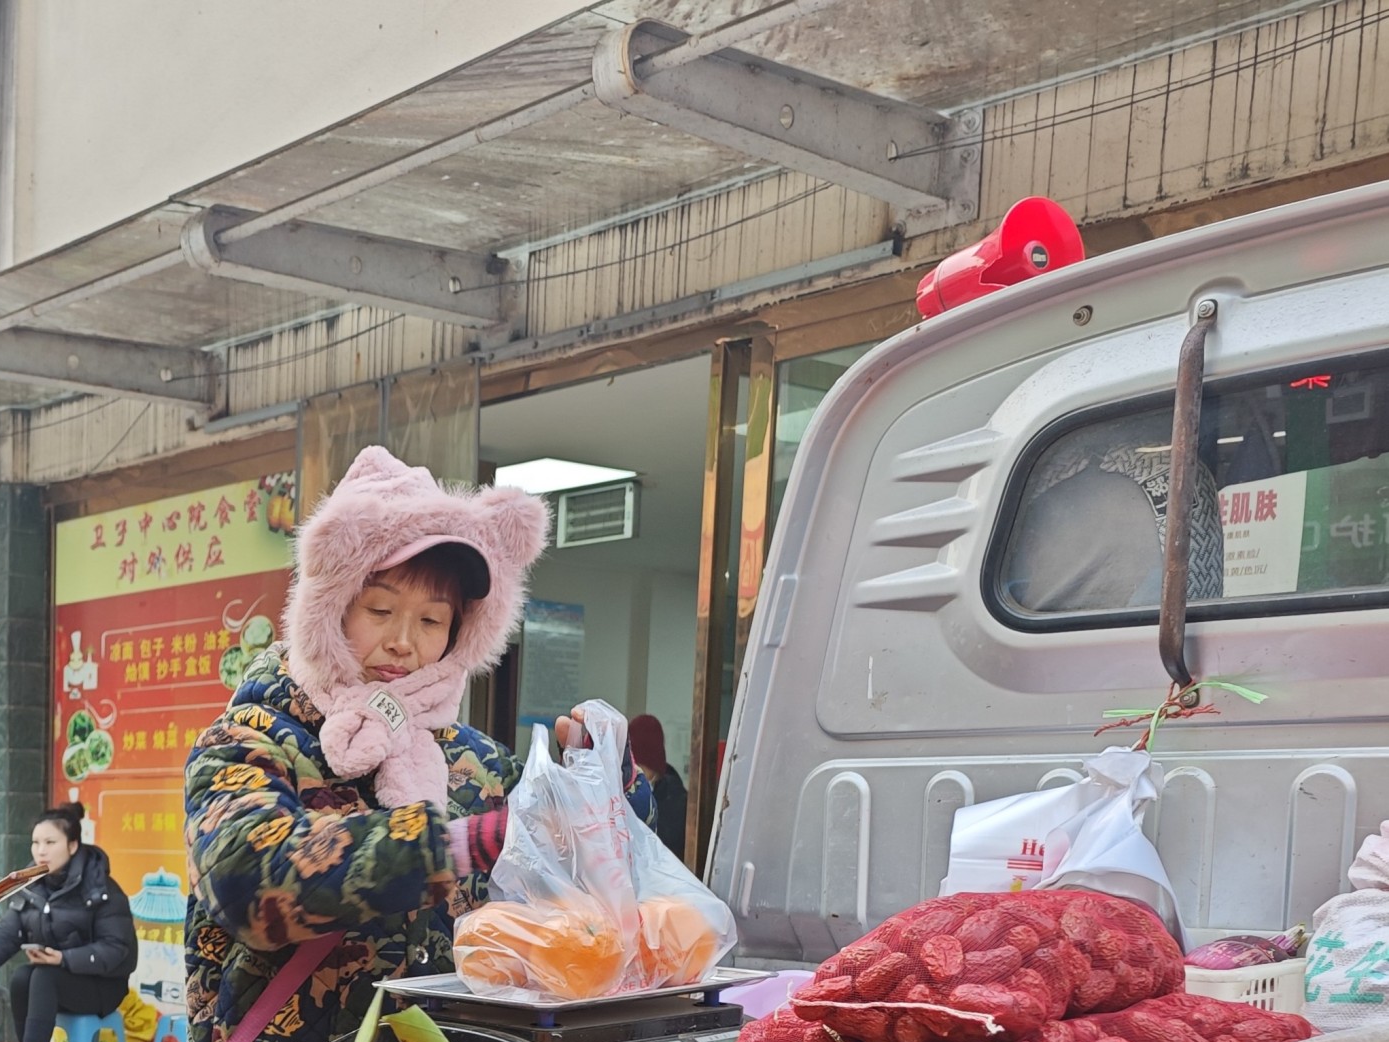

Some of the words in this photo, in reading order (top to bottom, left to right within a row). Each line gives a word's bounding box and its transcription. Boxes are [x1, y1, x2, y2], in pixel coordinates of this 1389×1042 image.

[118, 536, 225, 584] 对外供应
[171, 633, 197, 655] 米粉
